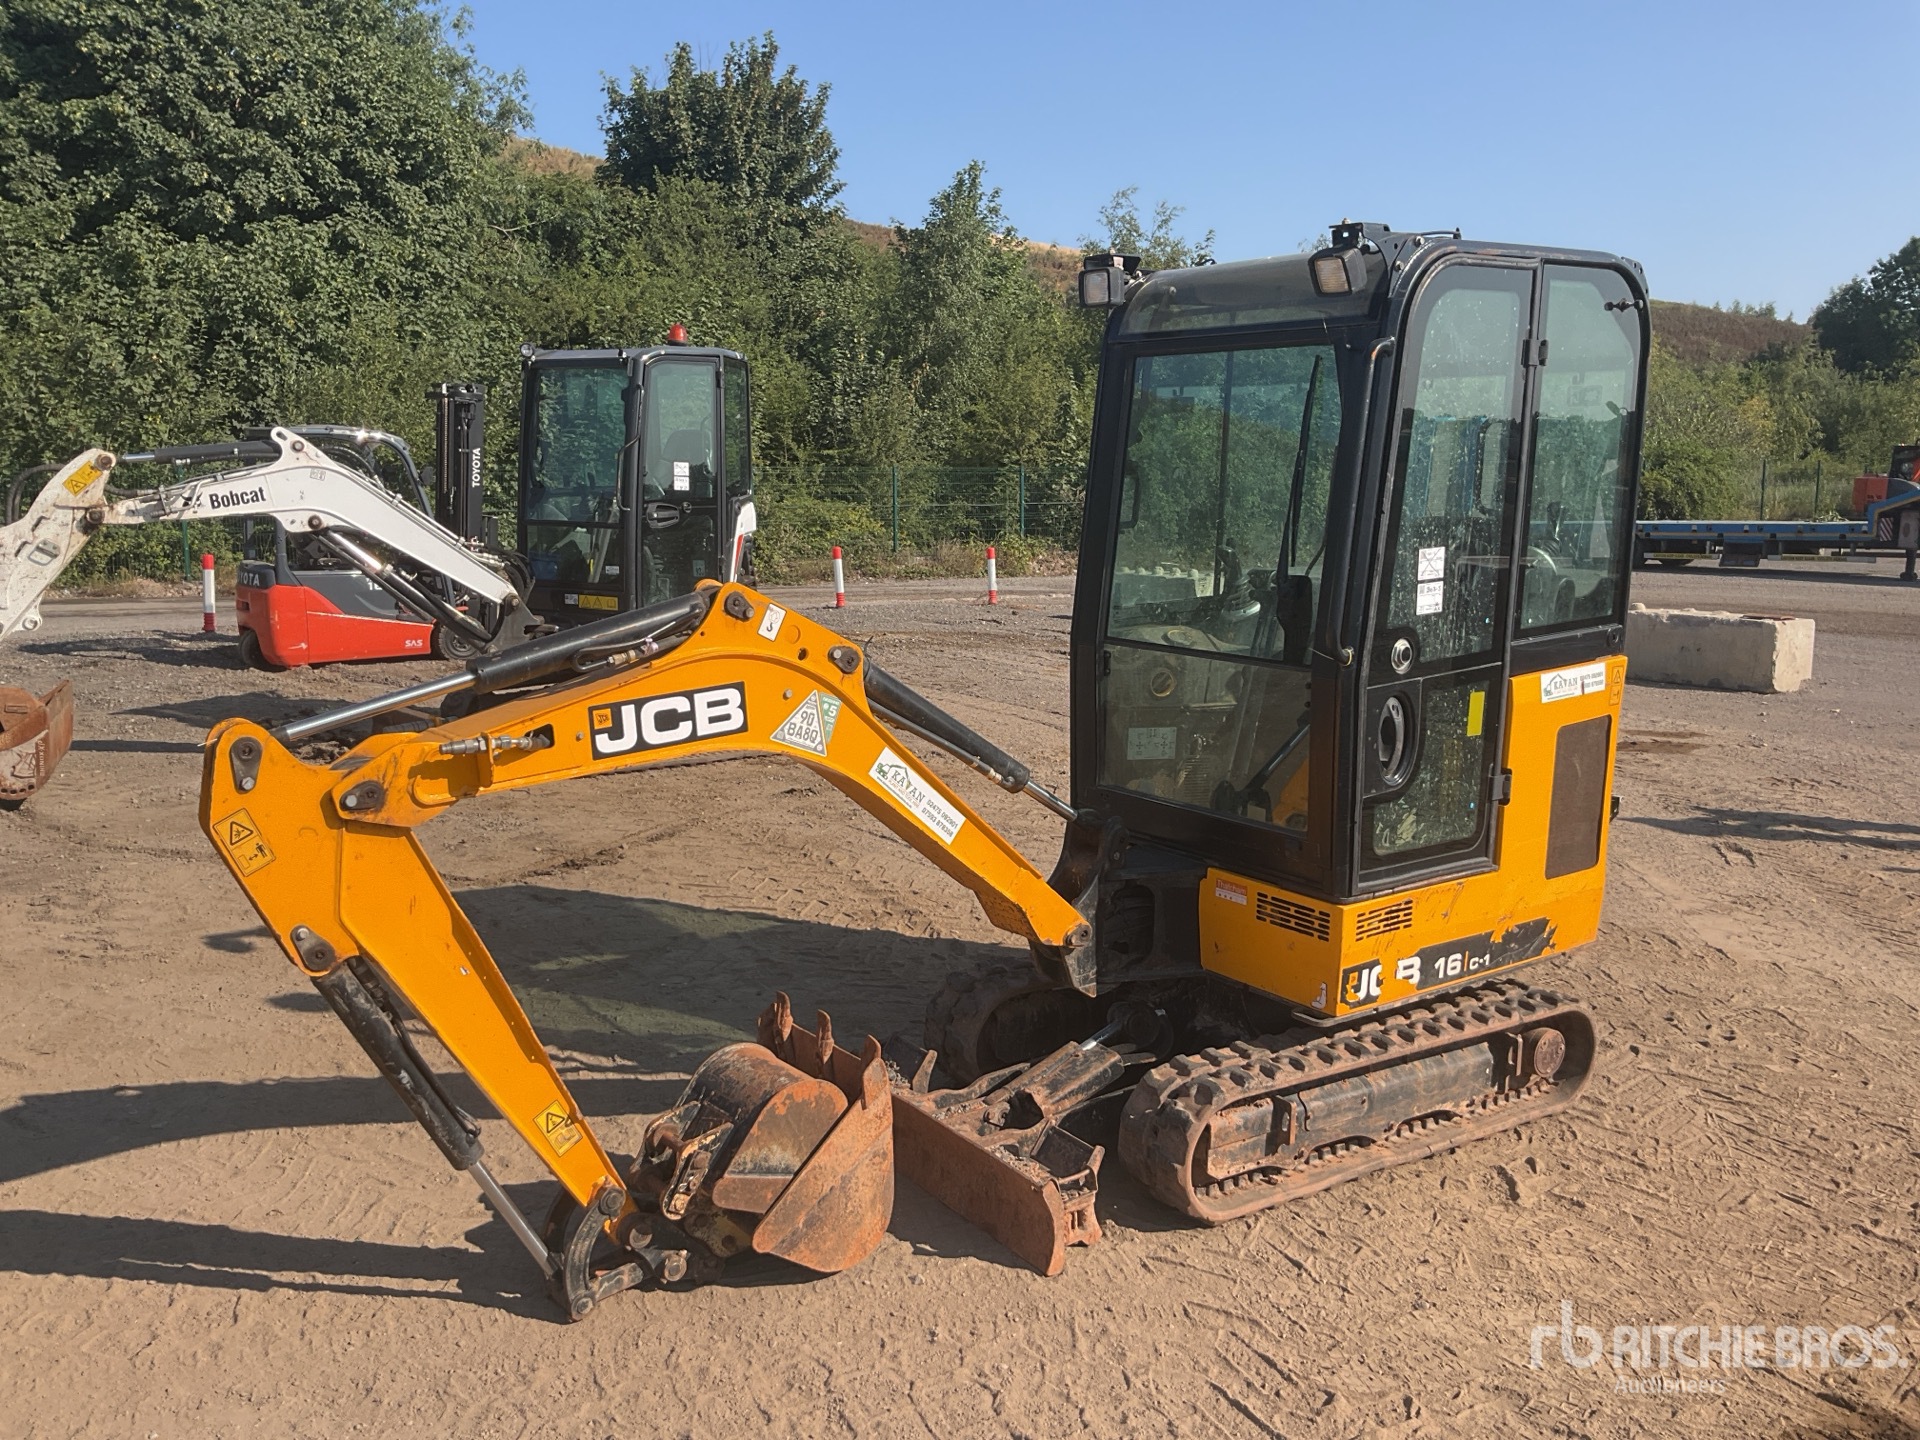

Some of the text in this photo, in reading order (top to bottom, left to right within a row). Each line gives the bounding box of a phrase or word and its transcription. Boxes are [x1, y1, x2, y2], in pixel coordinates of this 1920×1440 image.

[472, 447, 481, 488] TOYOTA
[209, 486, 266, 509] Bobcat
[405, 639, 423, 648] SAS
[595, 687, 745, 754] JCB
[787, 722, 819, 744] BA8Q
[891, 769, 926, 803] KAVAN
[1434, 952, 1463, 979] 16
